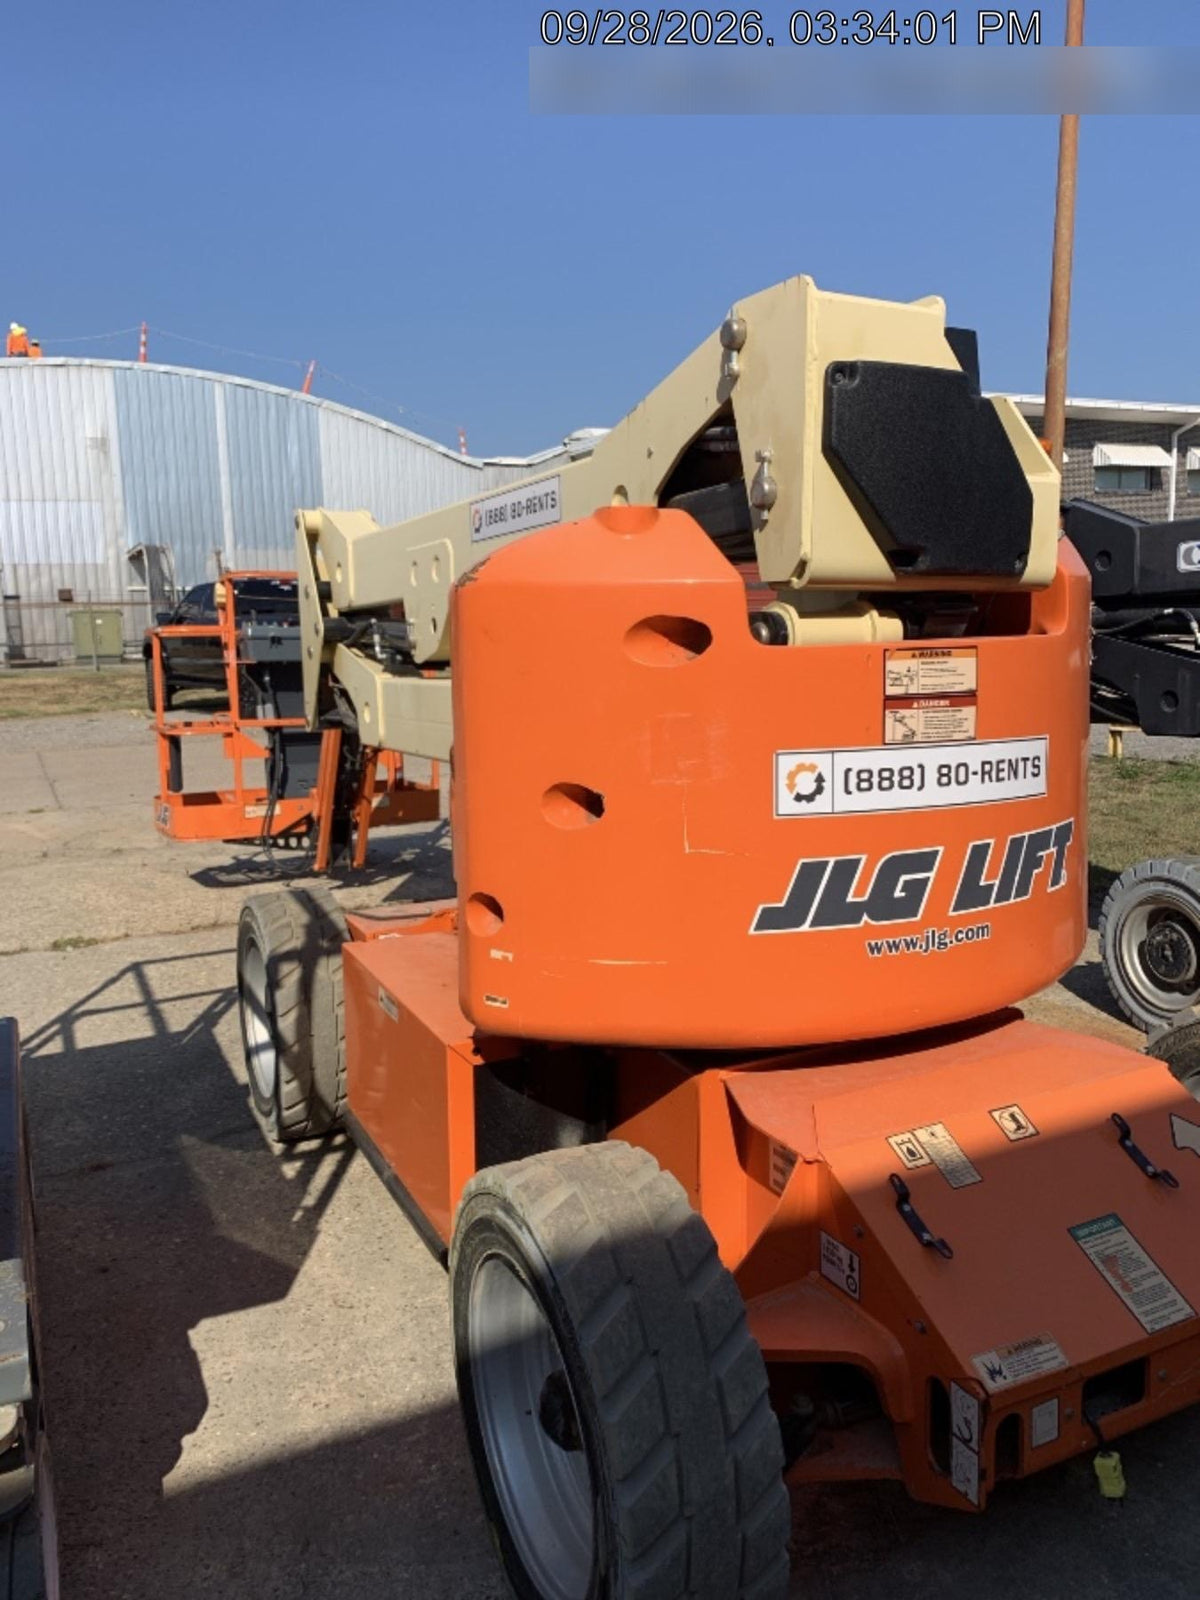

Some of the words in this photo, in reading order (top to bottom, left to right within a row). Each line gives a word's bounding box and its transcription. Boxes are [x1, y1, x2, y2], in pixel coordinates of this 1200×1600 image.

[844, 763, 926, 795] (888)
[936, 755, 1042, 787] 80-RENTS
[749, 846, 944, 935] JLG
[949, 818, 1074, 916] LIFT
[867, 923, 991, 956] www.jlg.com
